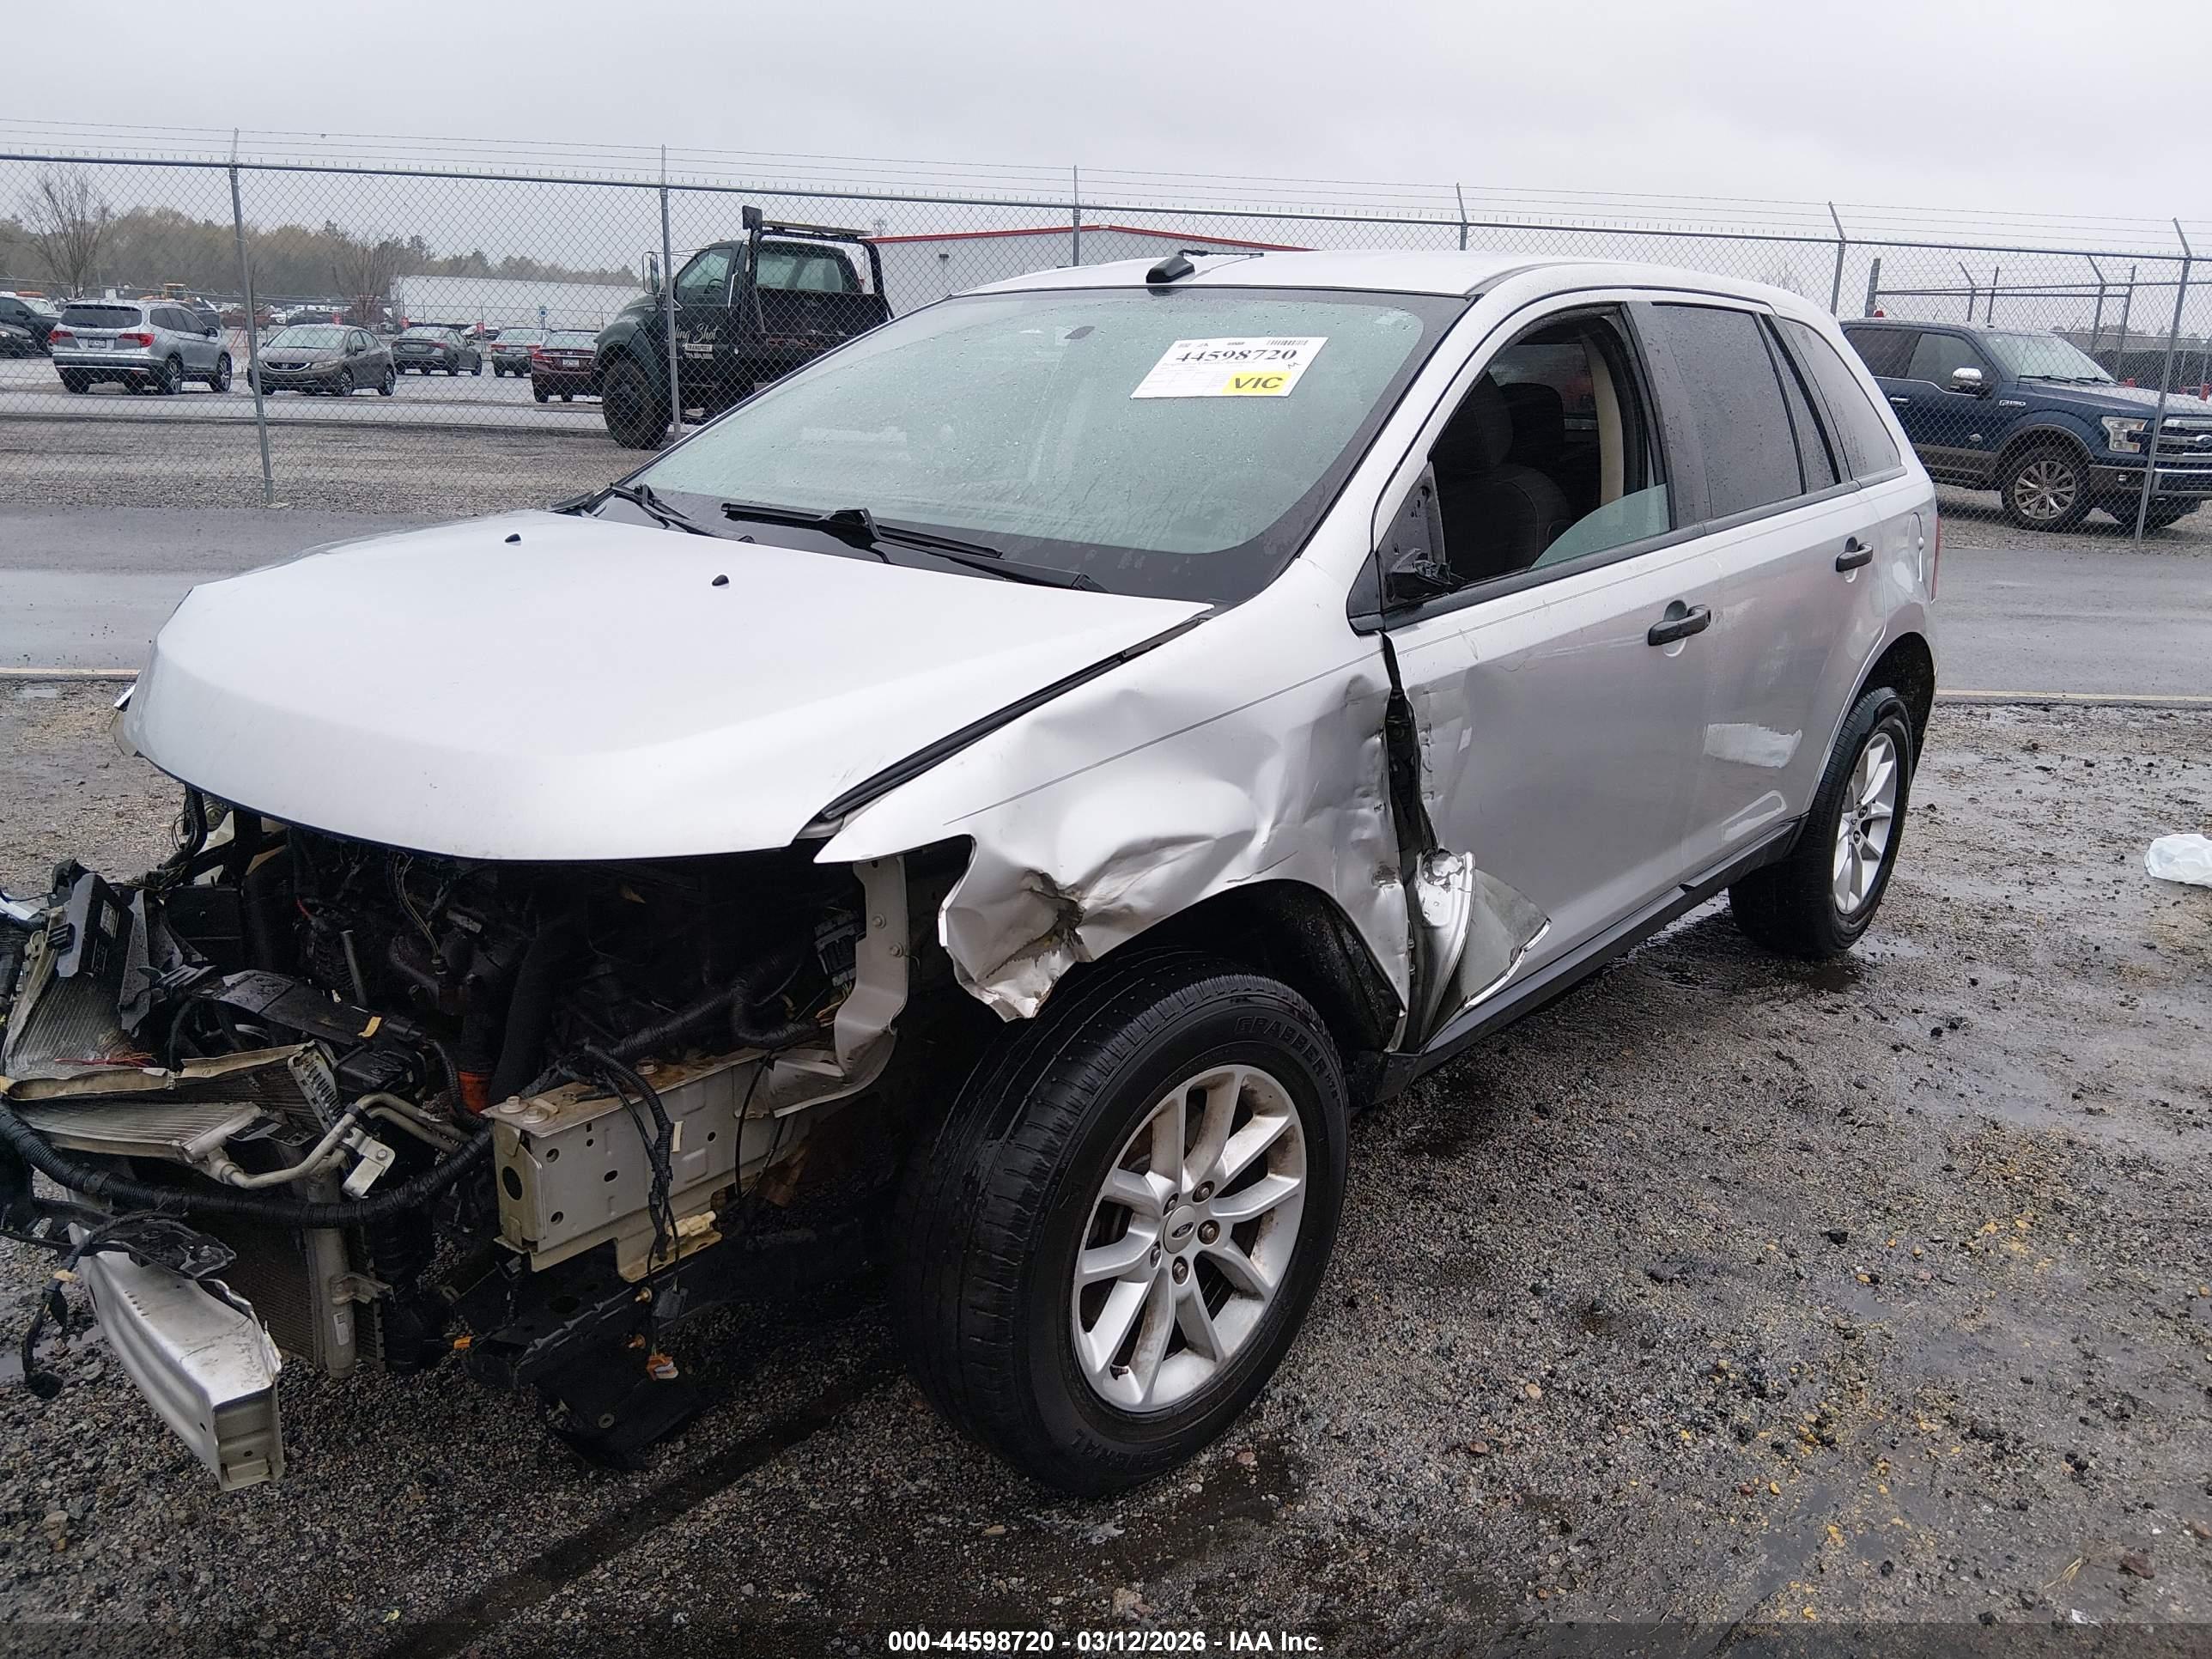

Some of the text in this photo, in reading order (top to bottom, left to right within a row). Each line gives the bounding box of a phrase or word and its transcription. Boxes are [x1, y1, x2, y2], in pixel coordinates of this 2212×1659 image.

[693, 323, 721, 343] Shot
[1176, 349, 1297, 362] 44598720
[1235, 377, 1283, 389] VIC
